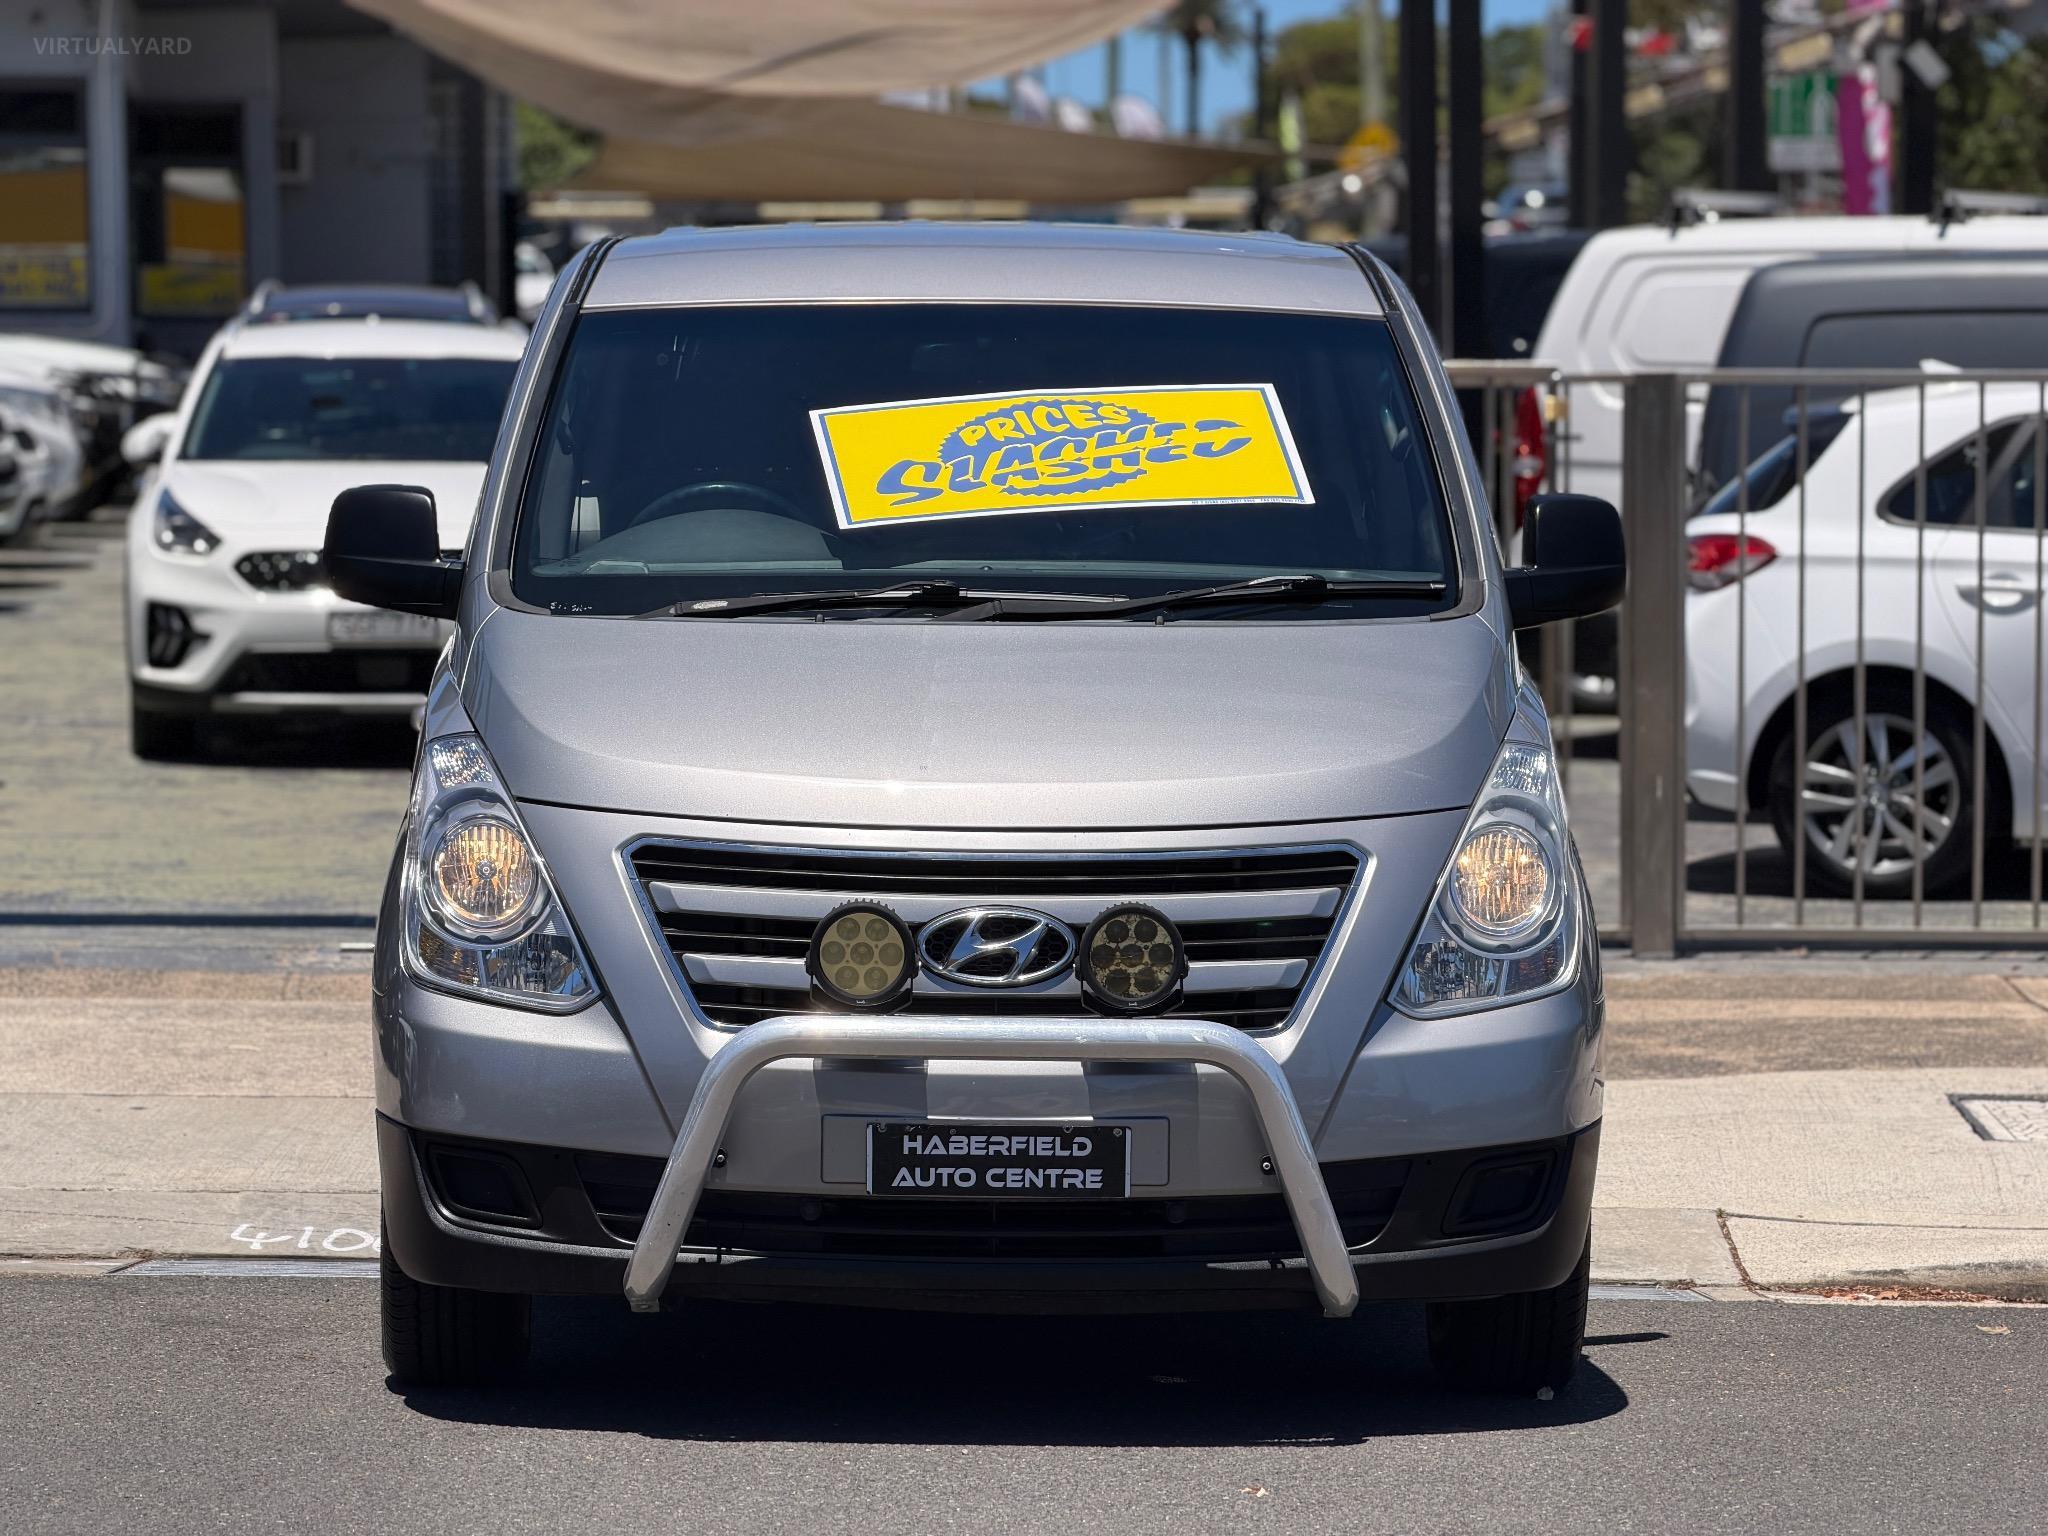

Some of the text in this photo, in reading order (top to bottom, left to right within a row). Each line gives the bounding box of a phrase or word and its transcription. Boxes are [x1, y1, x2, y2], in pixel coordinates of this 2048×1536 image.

[958, 404, 1131, 447] PRICES
[875, 419, 1253, 507] SLASHED
[903, 1135, 1092, 1157] HABERFIELD
[891, 1167, 1103, 1189] AUTO CENTRE
